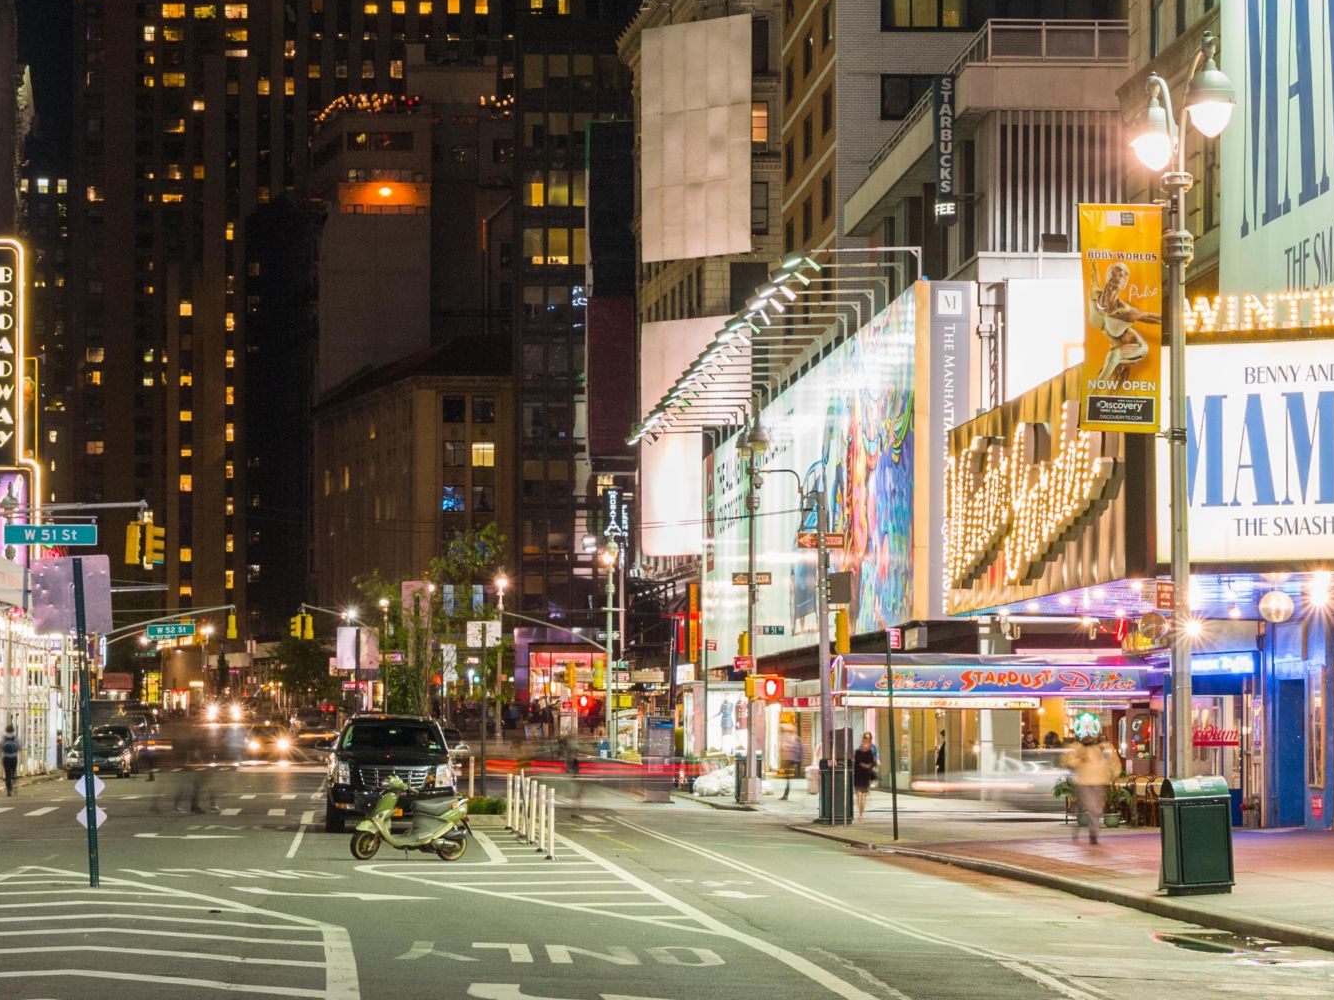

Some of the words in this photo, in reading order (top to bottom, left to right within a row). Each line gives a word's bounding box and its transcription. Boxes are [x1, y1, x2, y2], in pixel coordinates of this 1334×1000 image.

[939, 77, 952, 193] STARBUCKS
[1087, 251, 1114, 259] BODY
[1116, 252, 1157, 260] WORLDS
[1284, 237, 1310, 292] THE
[943, 323, 956, 350] THE
[1087, 380, 1119, 390] NOW
[1122, 380, 1156, 391] OPEN
[1244, 364, 1301, 386] BENNY
[1100, 400, 1143, 412] Discovery
[24, 529, 38, 541] W
[40, 529, 58, 541] 51
[61, 529, 78, 541] St
[1233, 517, 1269, 538] THE
[166, 626, 175, 634] 52
[874, 668, 952, 691] Ellen's
[959, 669, 1056, 692] STARDUST
[1057, 669, 1137, 692] Diner
[395, 940, 726, 967] ONLY
